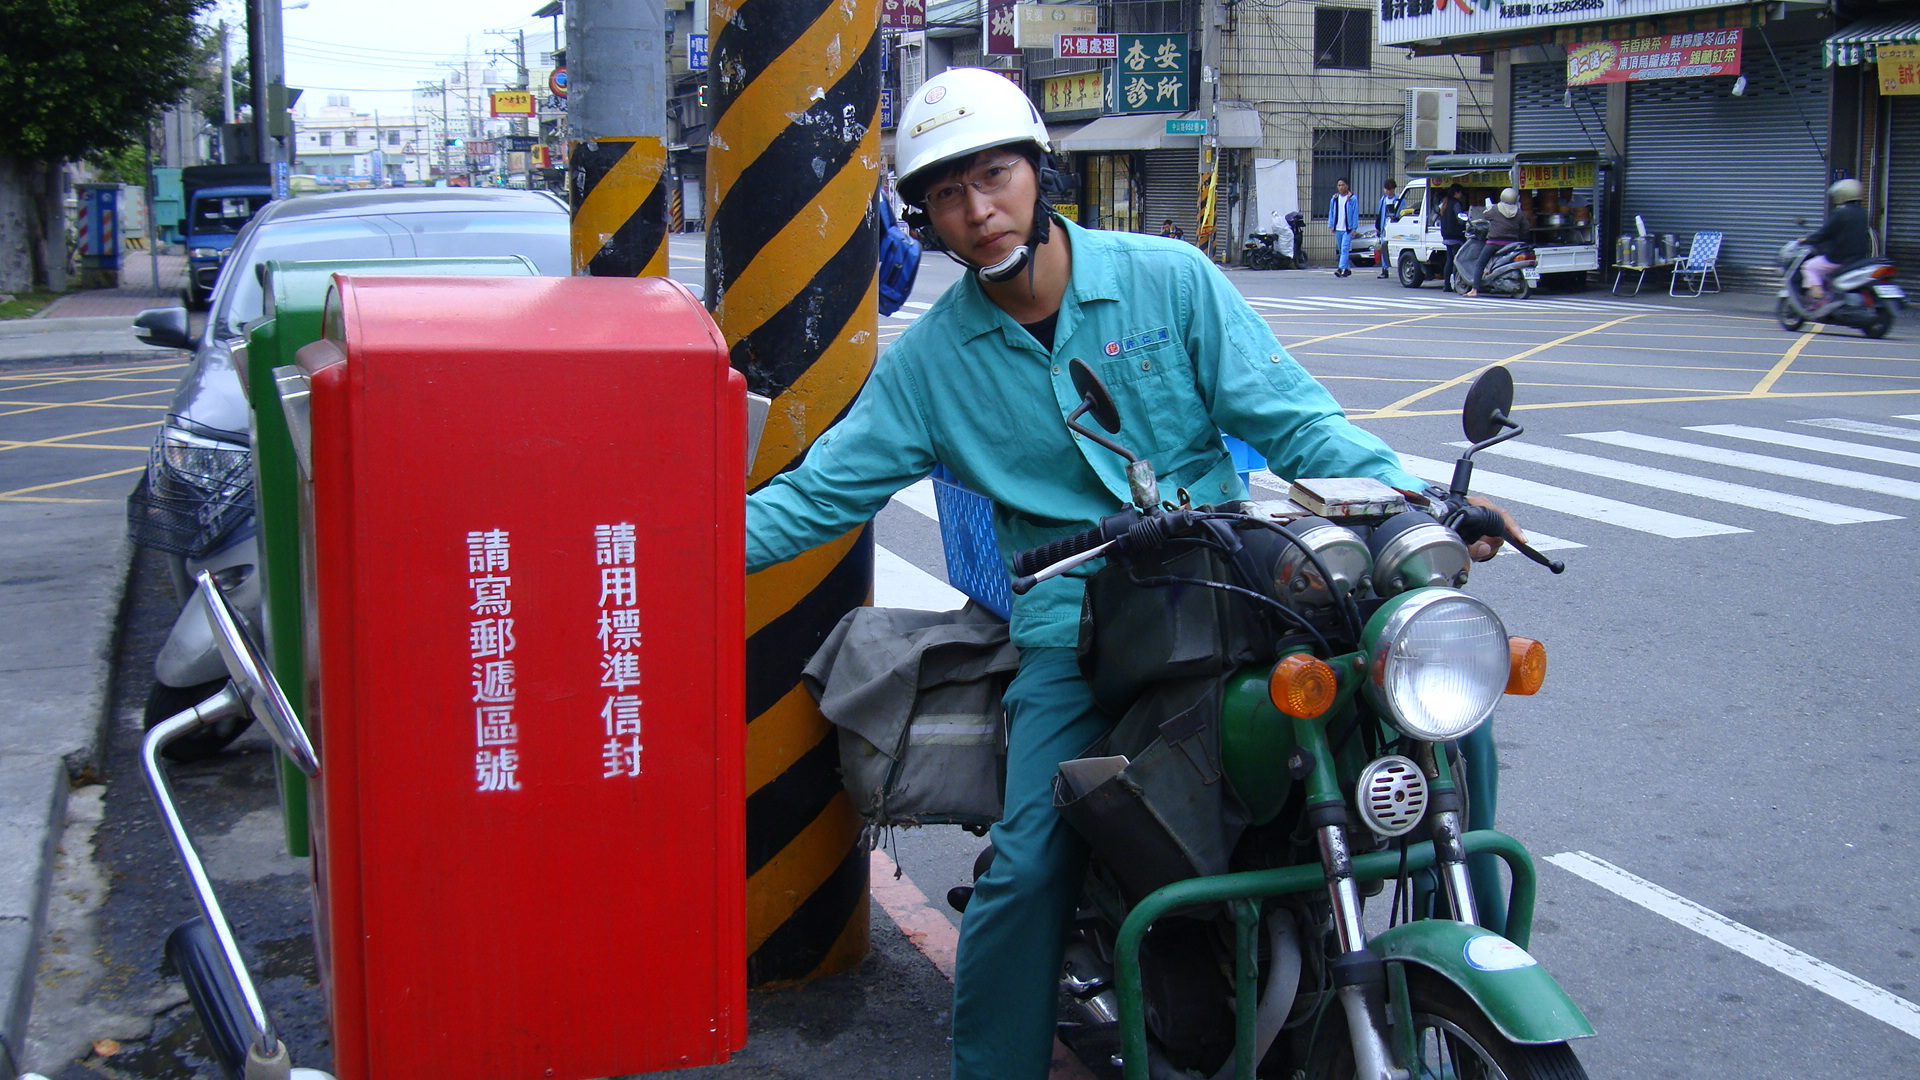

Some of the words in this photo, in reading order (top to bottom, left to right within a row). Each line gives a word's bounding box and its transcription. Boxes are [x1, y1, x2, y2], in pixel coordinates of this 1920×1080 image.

[1072, 9, 1094, 22] 車行
[1062, 37, 1116, 54] 外傷處理
[1124, 38, 1182, 71] 杏安
[1124, 75, 1183, 108] 診所
[467, 528, 521, 791] 請寫郵遞區號
[594, 522, 643, 778] 請用標準信封
